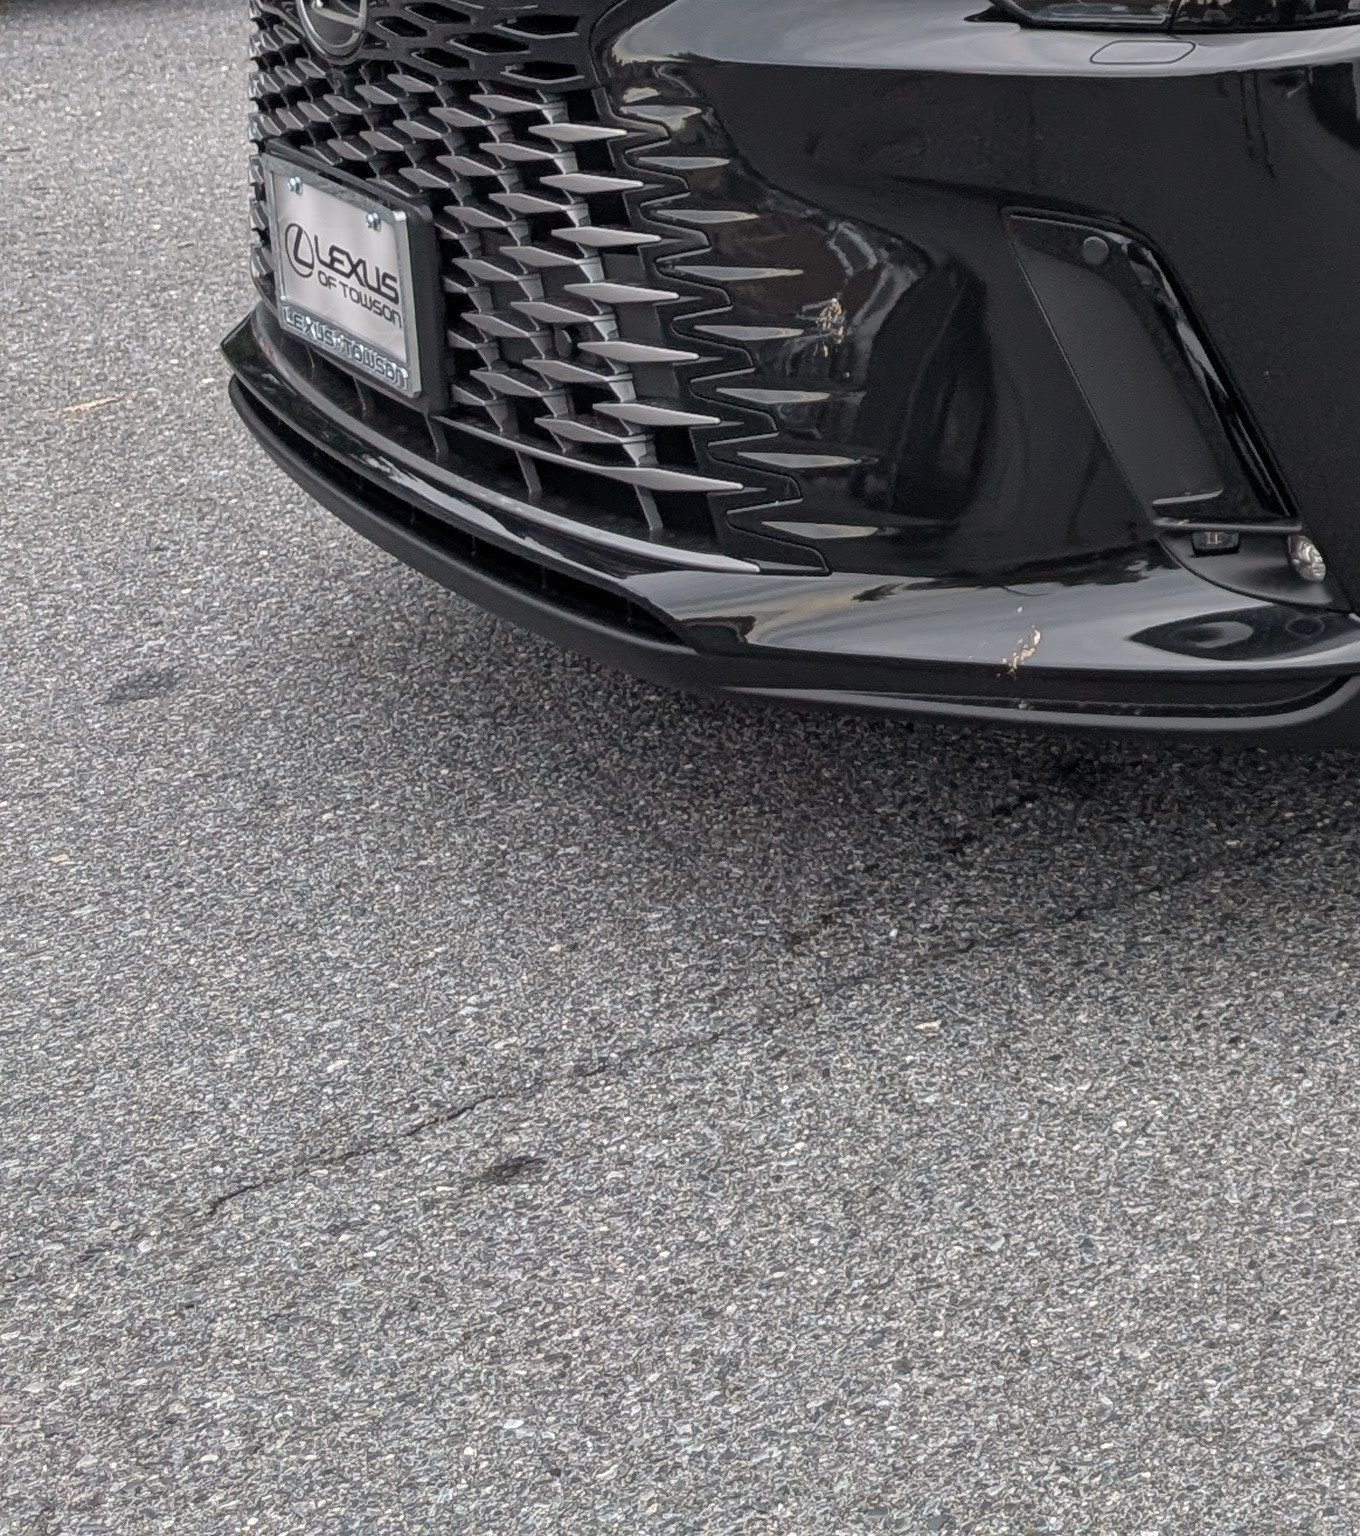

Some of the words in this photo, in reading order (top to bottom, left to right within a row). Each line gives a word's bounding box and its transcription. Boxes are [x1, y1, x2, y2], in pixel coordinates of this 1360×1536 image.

[314, 236, 399, 305] LEXUS
[317, 269, 337, 292] OF
[337, 279, 403, 328] TOWSON
